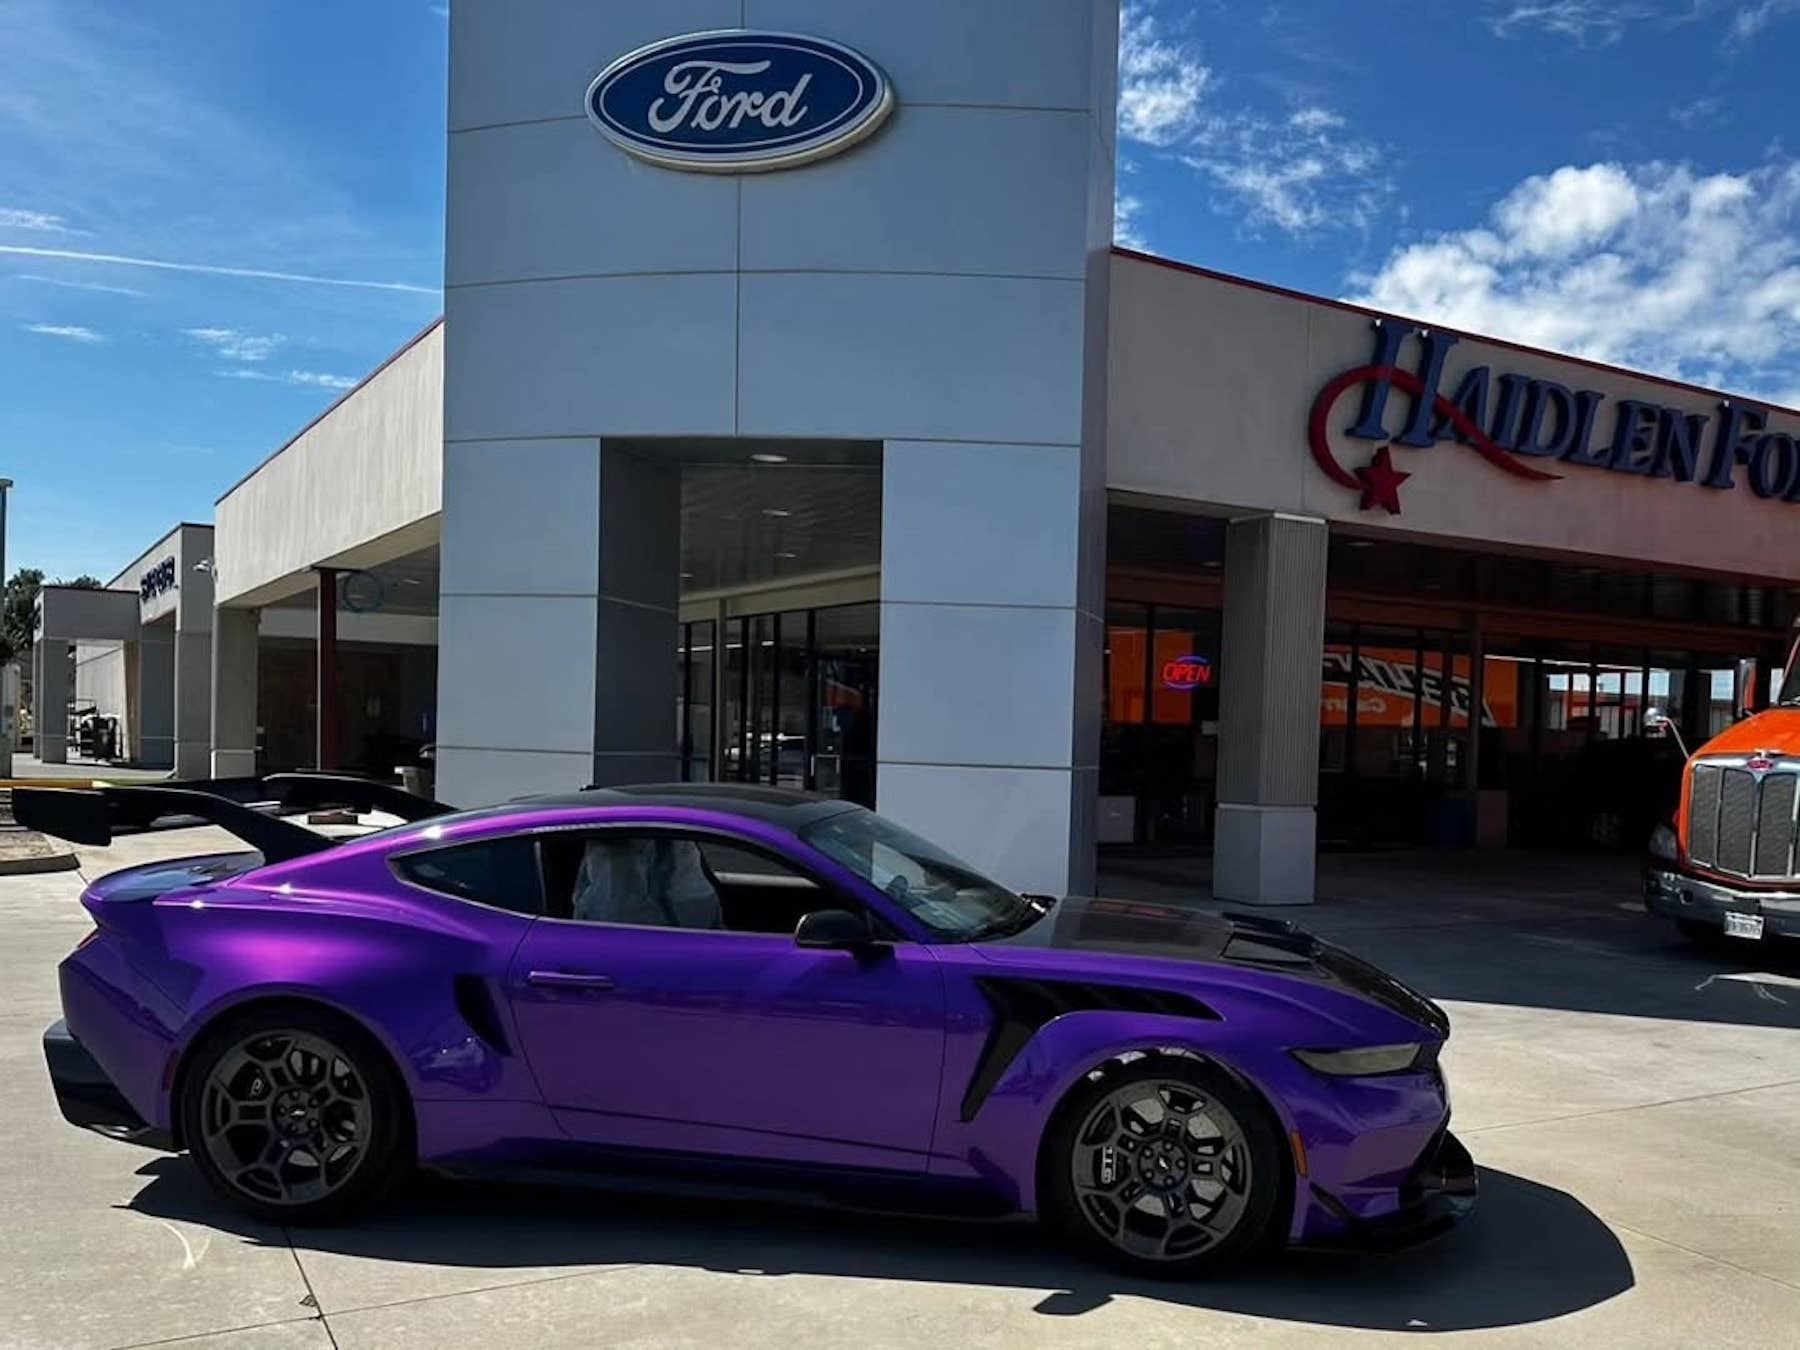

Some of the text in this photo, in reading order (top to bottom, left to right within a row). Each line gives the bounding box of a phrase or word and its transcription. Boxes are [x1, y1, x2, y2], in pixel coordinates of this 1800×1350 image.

[648, 60, 813, 133] Ford
[1345, 319, 1800, 504] HAIDLEN FO
[1162, 662, 1211, 681] OPEN
